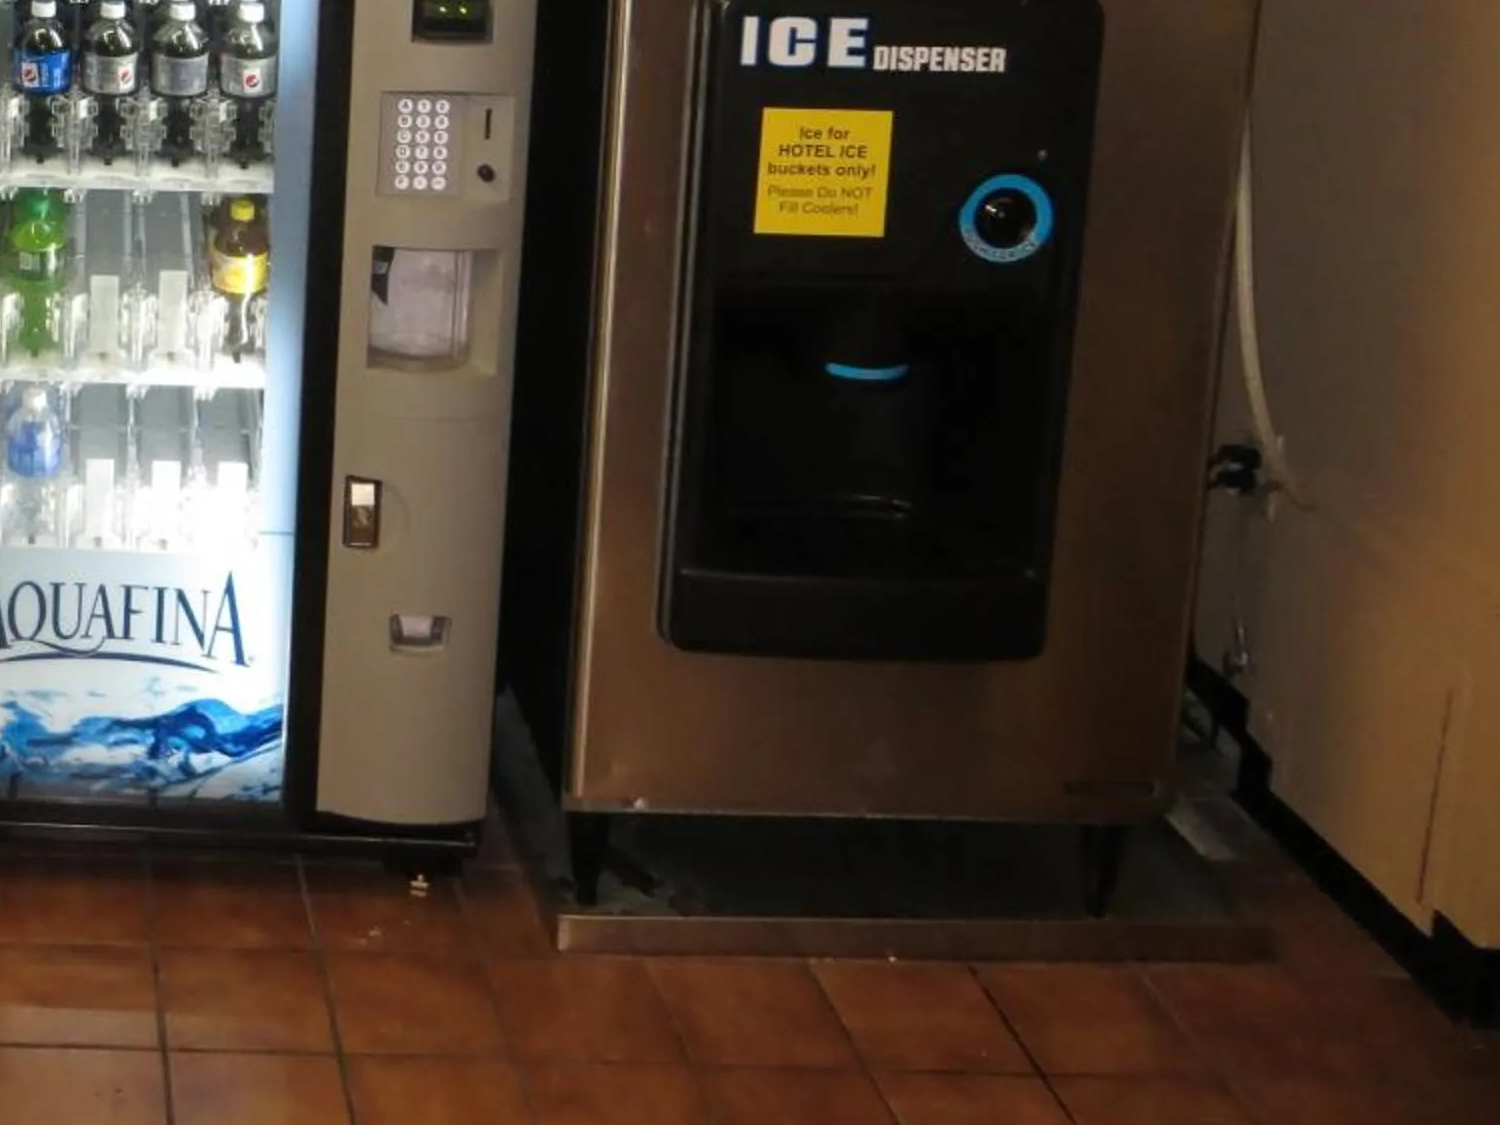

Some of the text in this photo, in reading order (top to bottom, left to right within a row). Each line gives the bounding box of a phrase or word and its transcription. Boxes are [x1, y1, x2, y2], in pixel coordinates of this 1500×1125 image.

[740, 15, 1007, 72] ICE DISPENSER
[799, 126, 851, 140] Ice for
[778, 144, 868, 159] HOTEL ICE
[767, 162, 876, 179] buckets only!
[817, 186, 837, 198] Do
[841, 186, 873, 200] NOT
